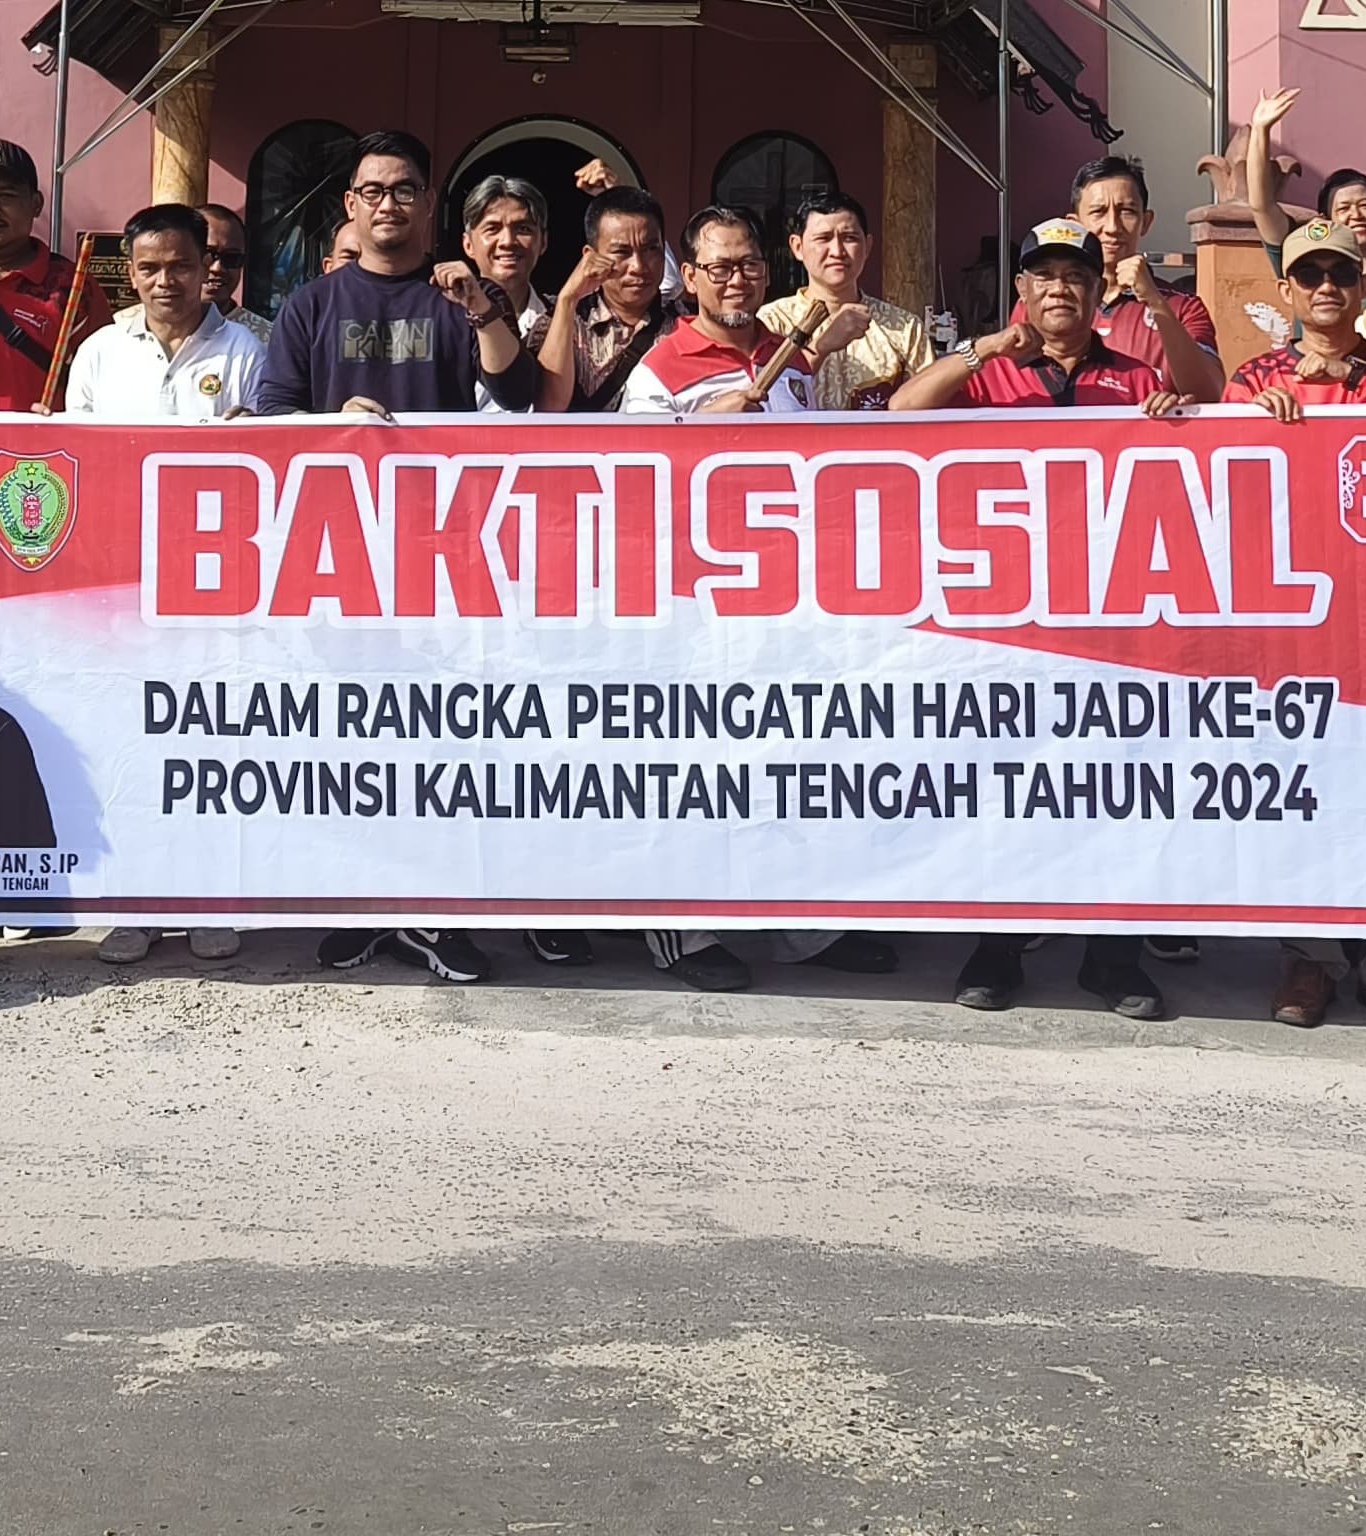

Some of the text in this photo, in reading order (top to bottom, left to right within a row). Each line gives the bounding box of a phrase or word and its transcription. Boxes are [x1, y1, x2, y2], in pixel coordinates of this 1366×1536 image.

[345, 320, 428, 343] CALVIN
[155, 456, 1319, 620] BAKTI SOSIAL
[143, 681, 1335, 740] DALAM RANGKA PERINGATAN HARI JADI KE-67
[162, 759, 1319, 822] PROVINSI KALIMANTAN TENGAH TAHUN 2024
[2, 877, 49, 891] TENGAH
[39, 853, 80, 874] S.IP
